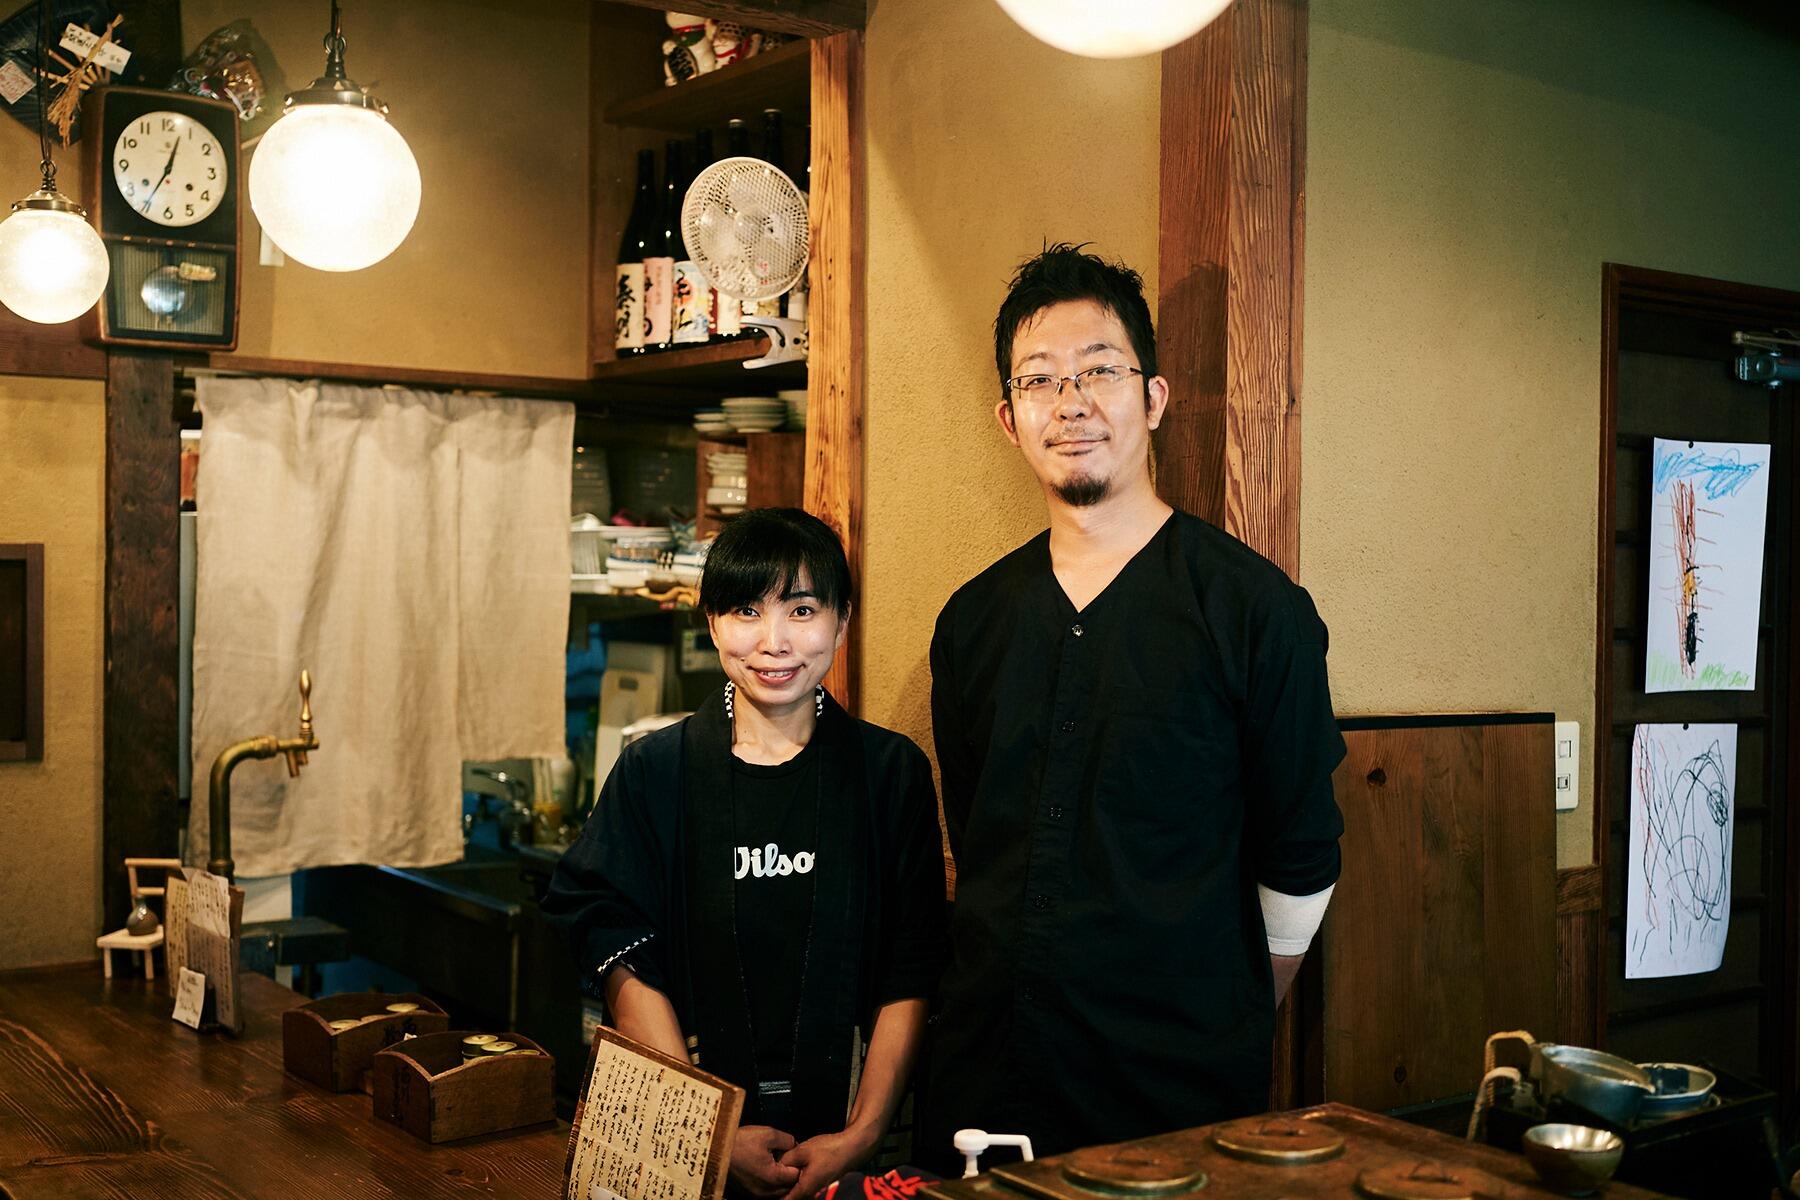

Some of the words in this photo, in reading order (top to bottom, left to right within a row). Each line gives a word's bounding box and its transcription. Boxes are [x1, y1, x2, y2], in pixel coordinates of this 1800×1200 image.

[140, 122, 150, 135] 11
[162, 118, 175, 132] 12
[188, 127, 193, 140] 1
[123, 136, 137, 149] 10
[202, 143, 211, 156] 2
[119, 159, 129, 173] 9
[207, 168, 216, 180] 3
[200, 190, 210, 202] 4
[163, 206, 173, 220] 6
[185, 204, 194, 217] 5
[734, 843, 815, 880] ilso
